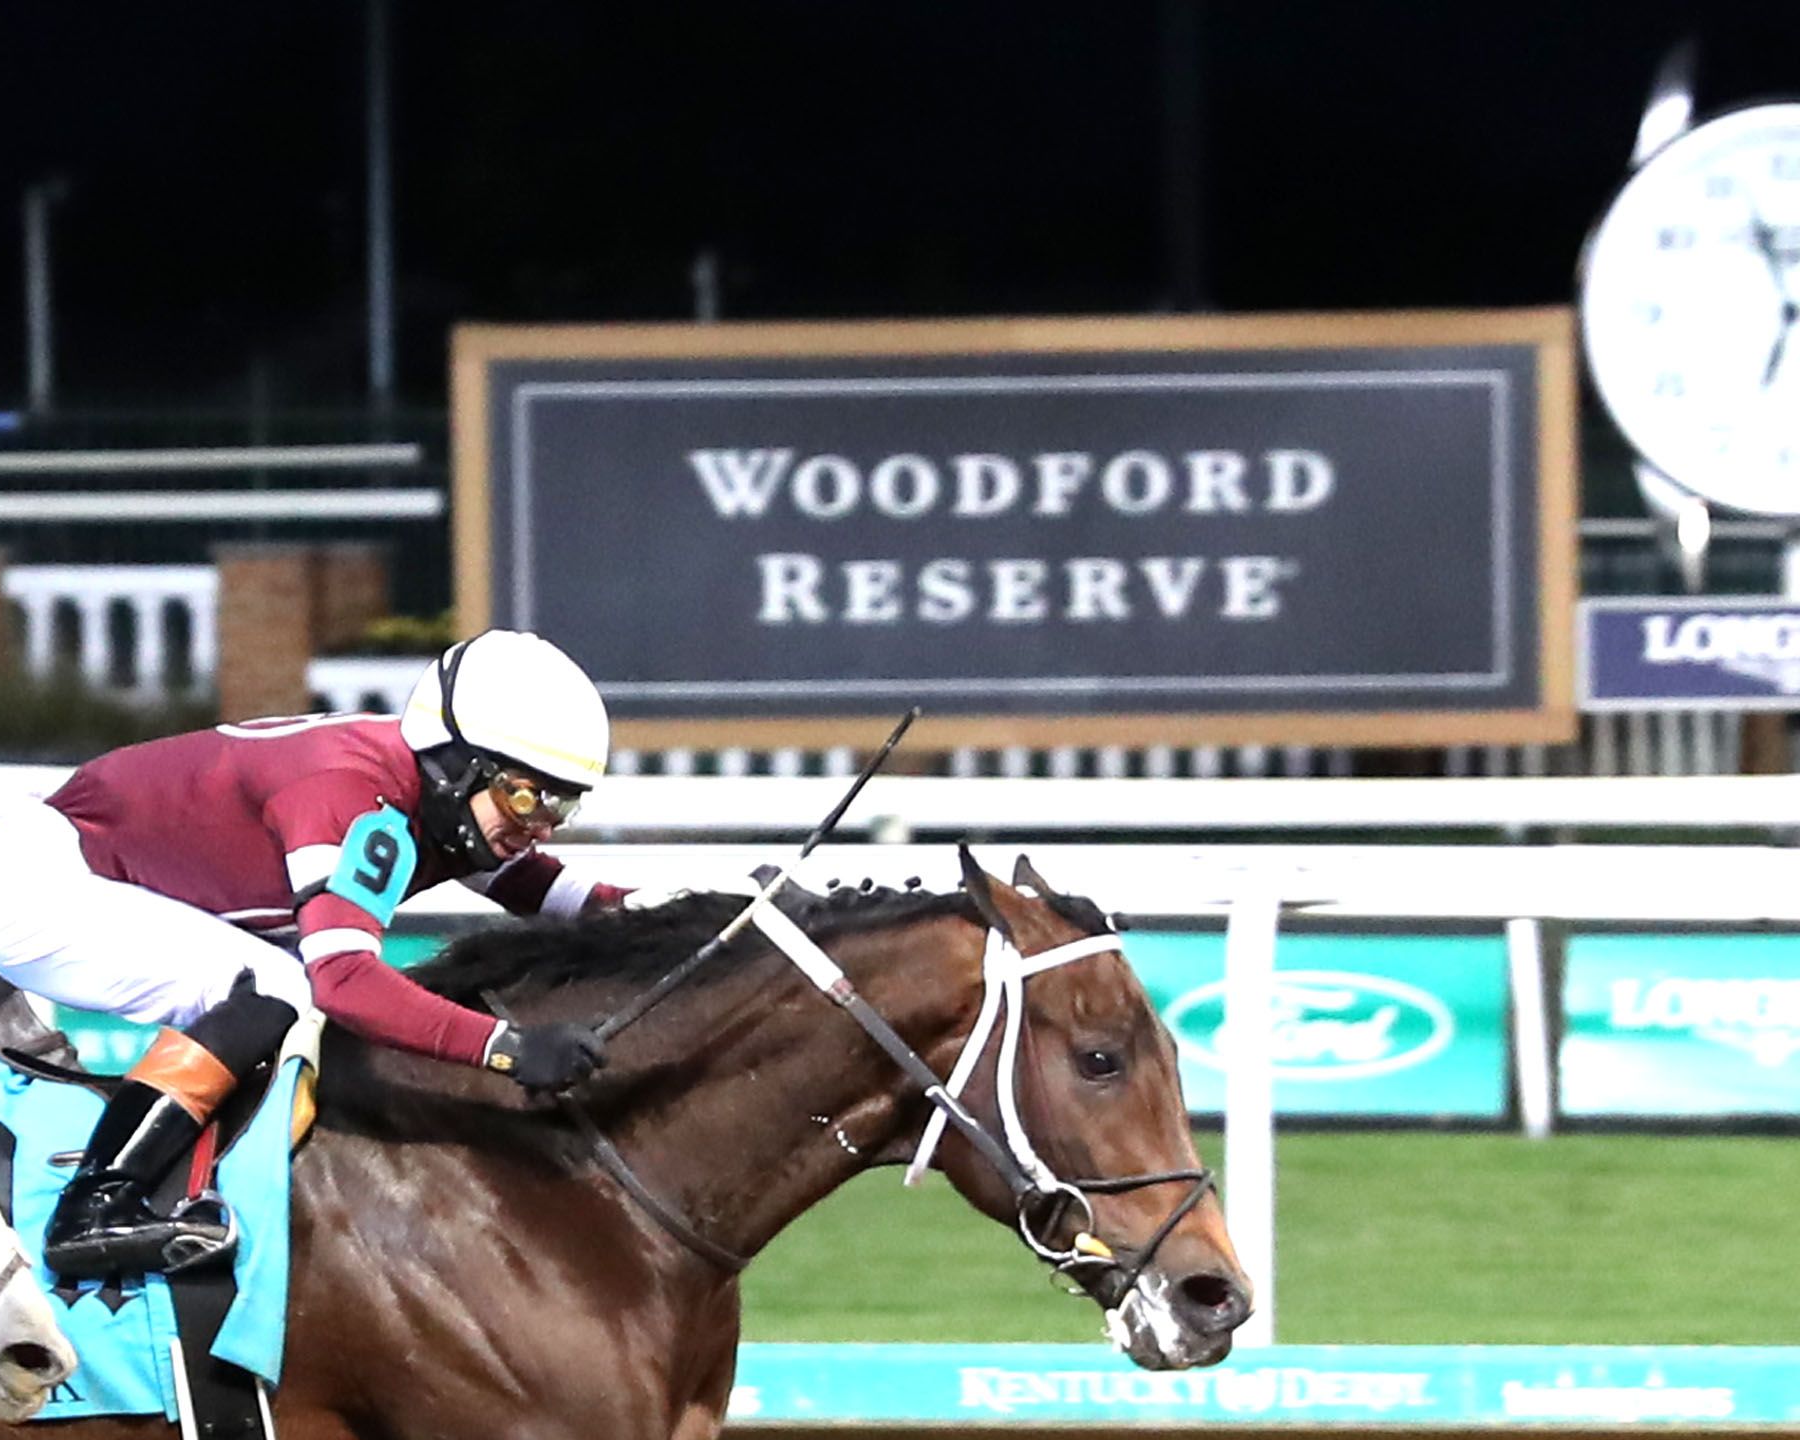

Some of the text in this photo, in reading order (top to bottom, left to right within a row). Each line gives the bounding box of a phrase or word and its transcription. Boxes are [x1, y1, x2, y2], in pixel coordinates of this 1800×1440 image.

[689, 448, 1335, 518] WOODFORD
[756, 553, 1282, 623] RESERVE
[352, 828, 399, 896] 9
